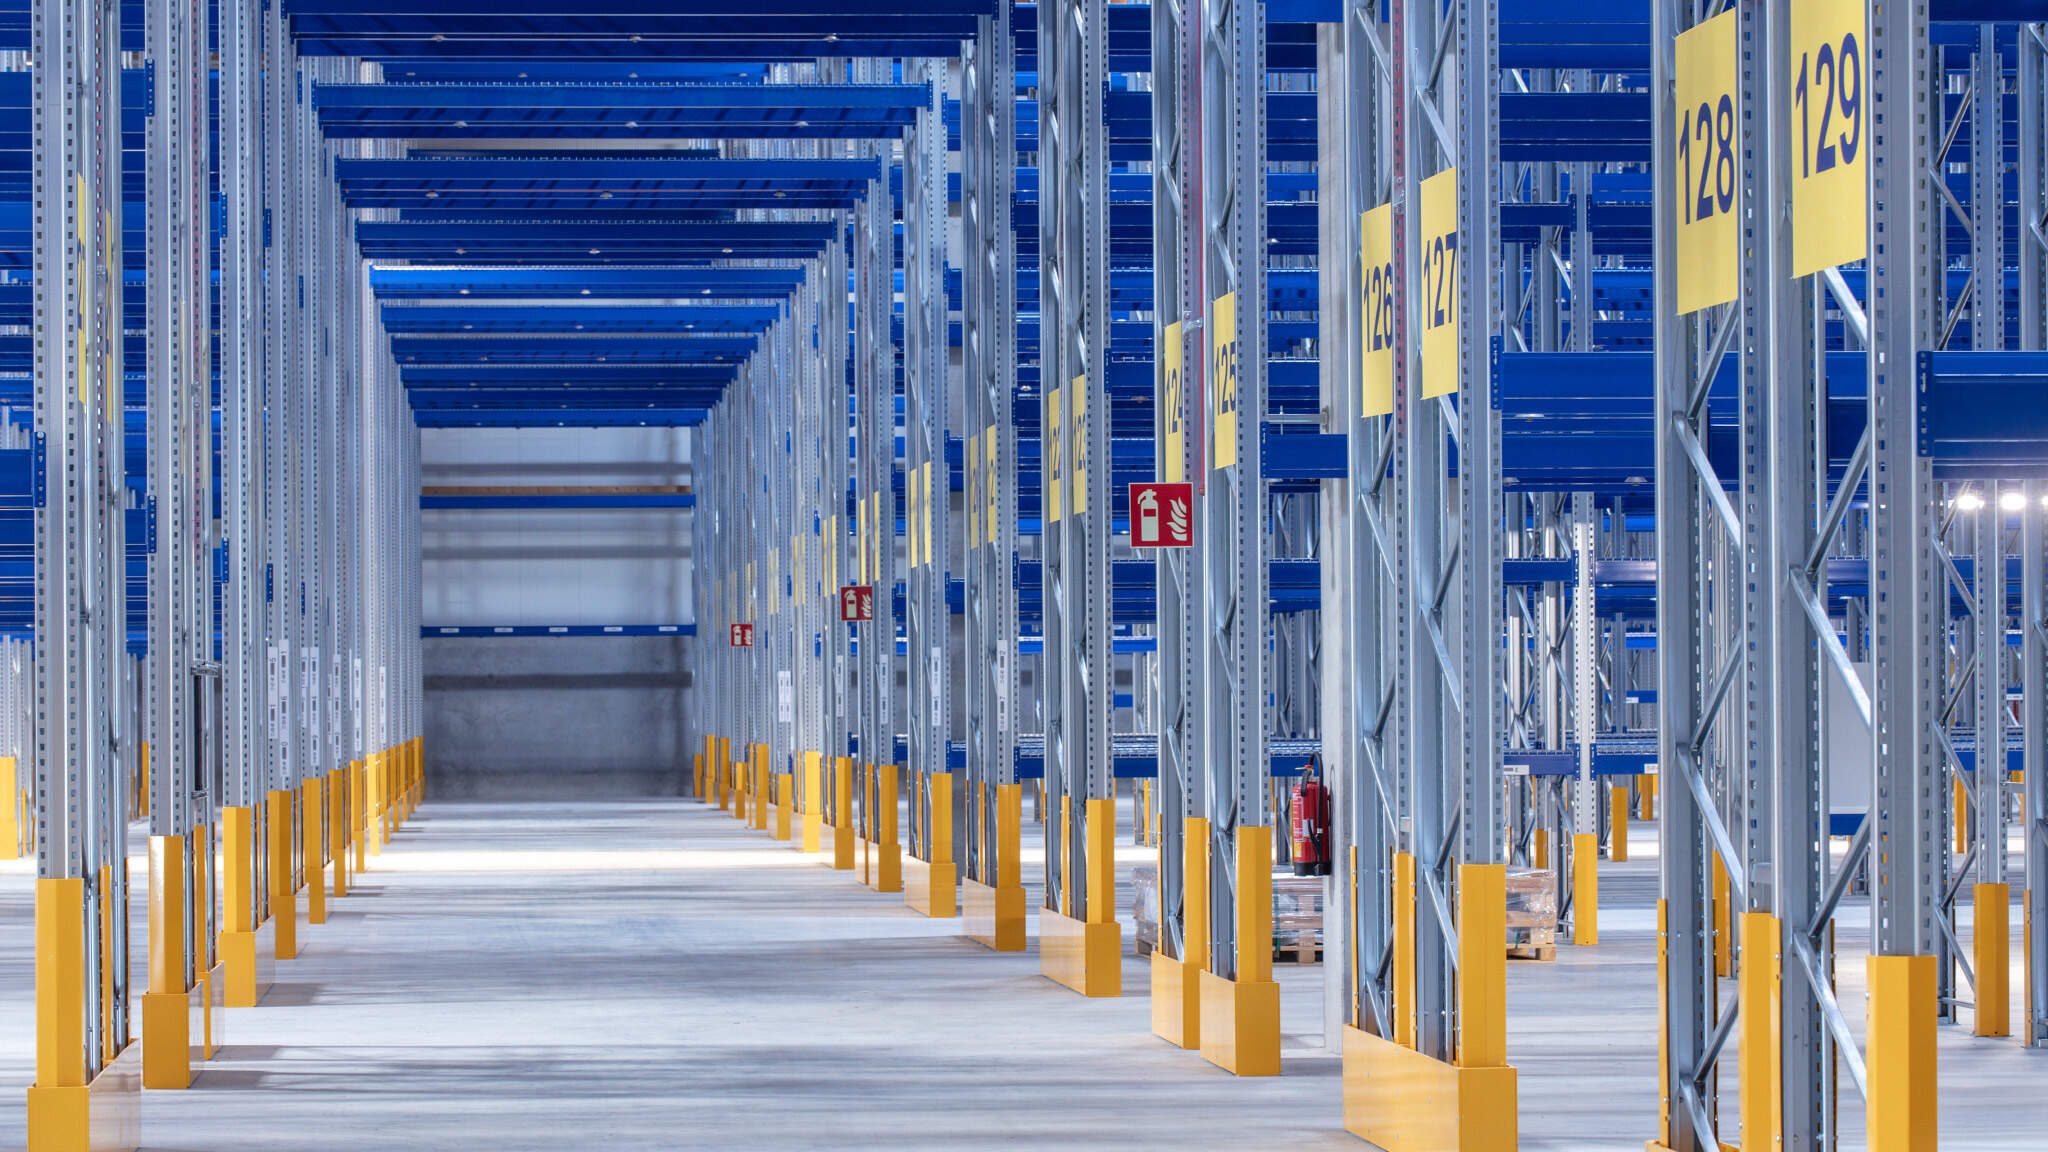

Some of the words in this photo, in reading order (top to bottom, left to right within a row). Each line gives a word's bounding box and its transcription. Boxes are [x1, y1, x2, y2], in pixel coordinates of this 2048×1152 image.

[1795, 32, 1861, 179] 129
[1679, 93, 1735, 225] 128
[1363, 261, 1393, 353] 126
[1424, 231, 1457, 330] 127
[1215, 341, 1237, 416] 125
